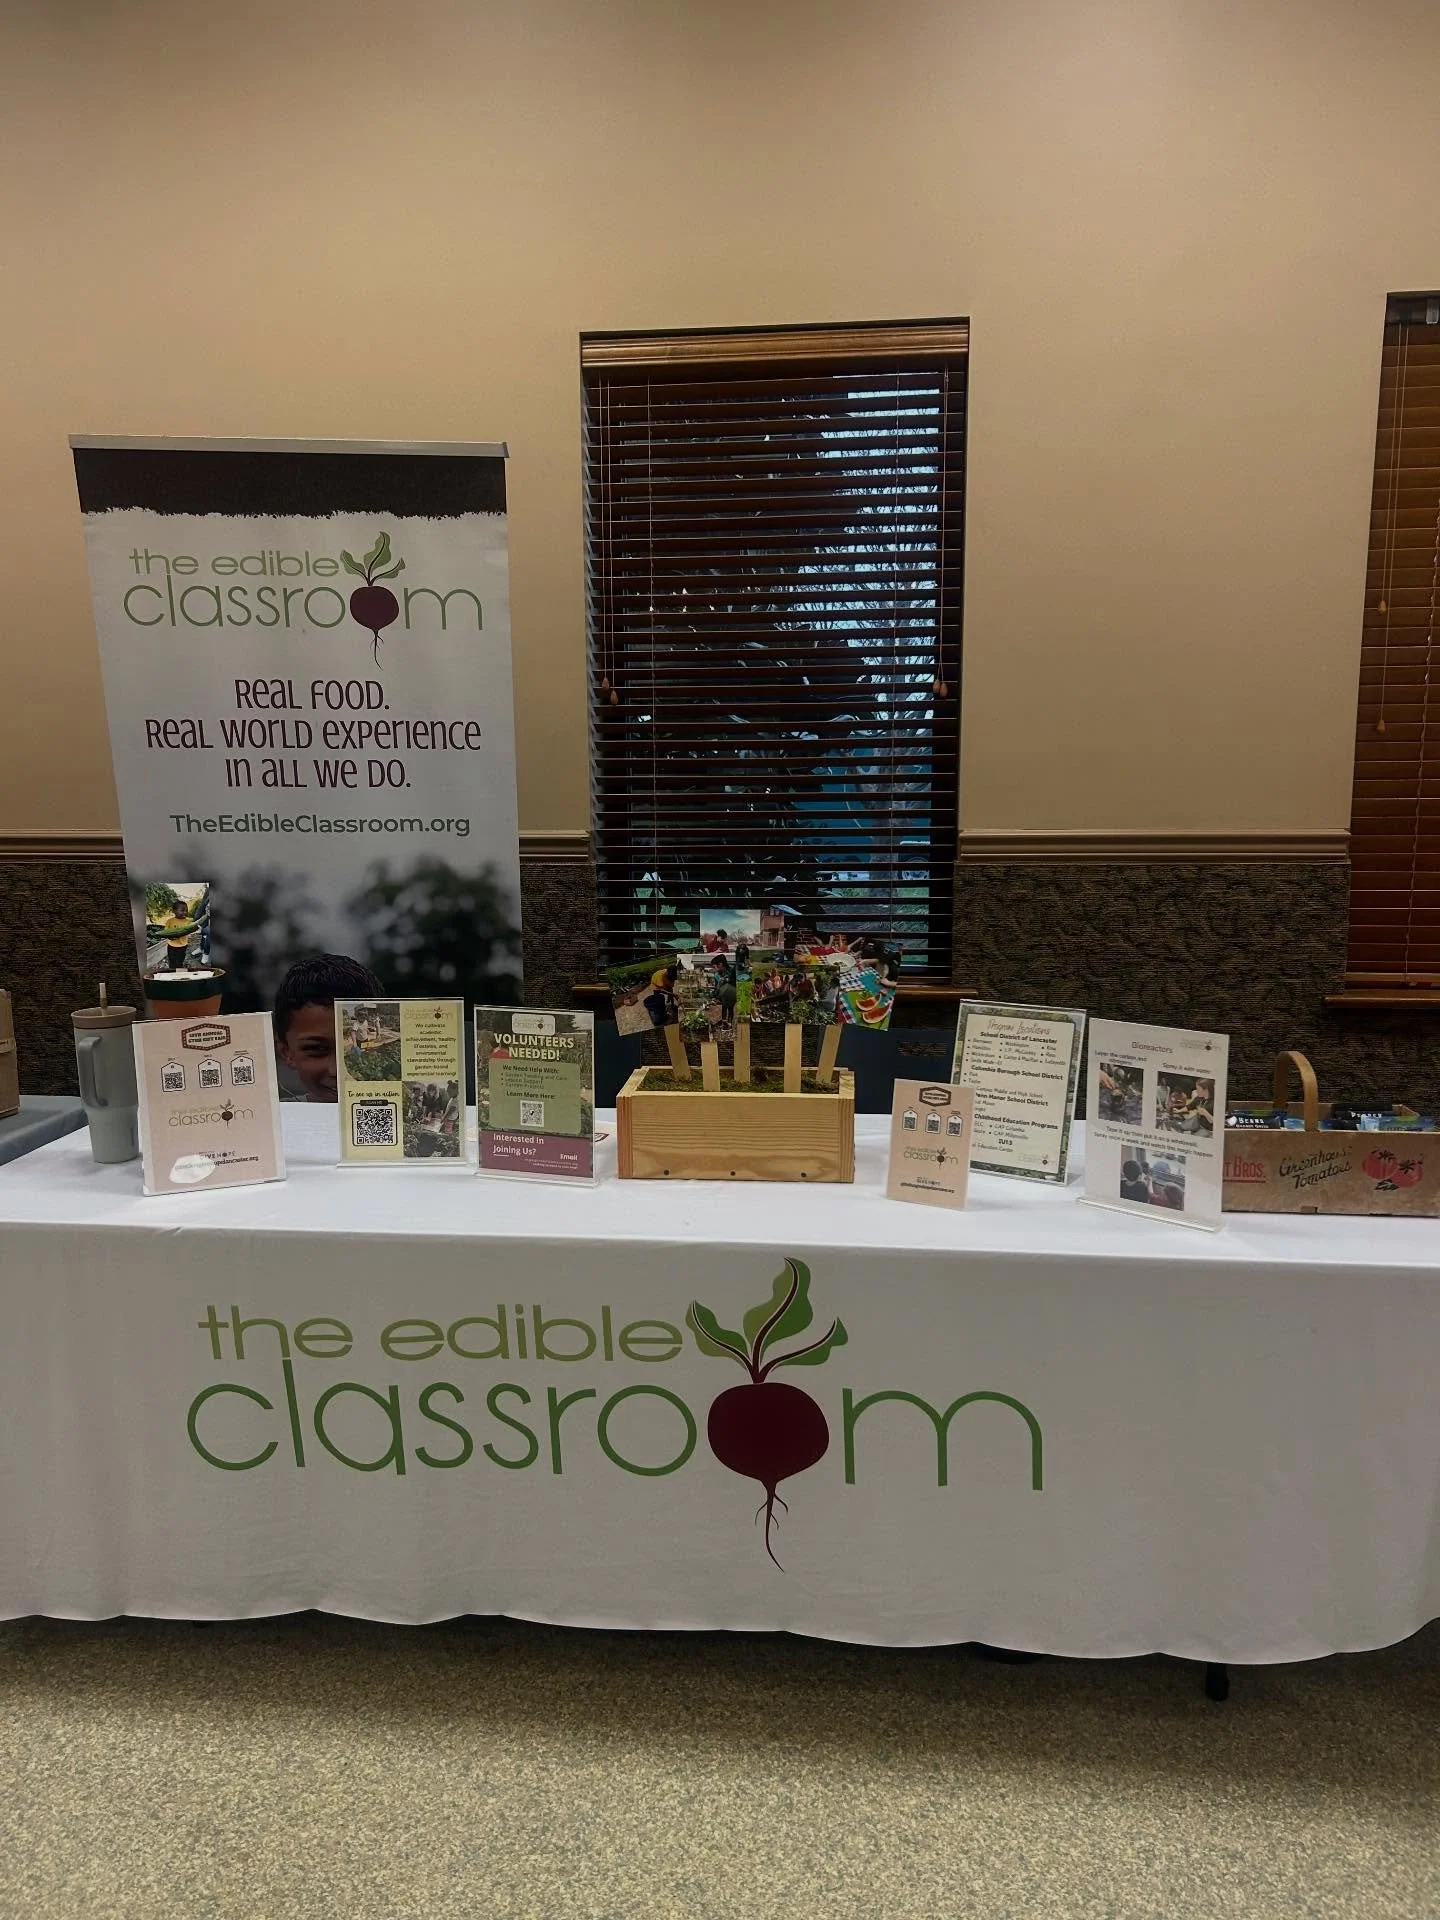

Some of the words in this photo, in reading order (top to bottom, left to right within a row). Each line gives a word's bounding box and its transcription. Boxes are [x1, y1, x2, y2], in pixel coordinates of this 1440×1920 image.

[129, 547, 200, 577] the
[211, 550, 339, 577] edible
[311, 679, 391, 711] FOOD.
[368, 758, 412, 789] DO.
[170, 813, 471, 838] TheEdibleClassroom.org
[494, 1032, 574, 1049] VOLUNTEERS
[508, 1046, 560, 1061] NEEDED!
[493, 1133, 534, 1144] Interested
[493, 1144, 521, 1156] Joining
[560, 1153, 578, 1161] Email
[198, 1304, 354, 1361] the
[380, 1302, 683, 1362] edible
